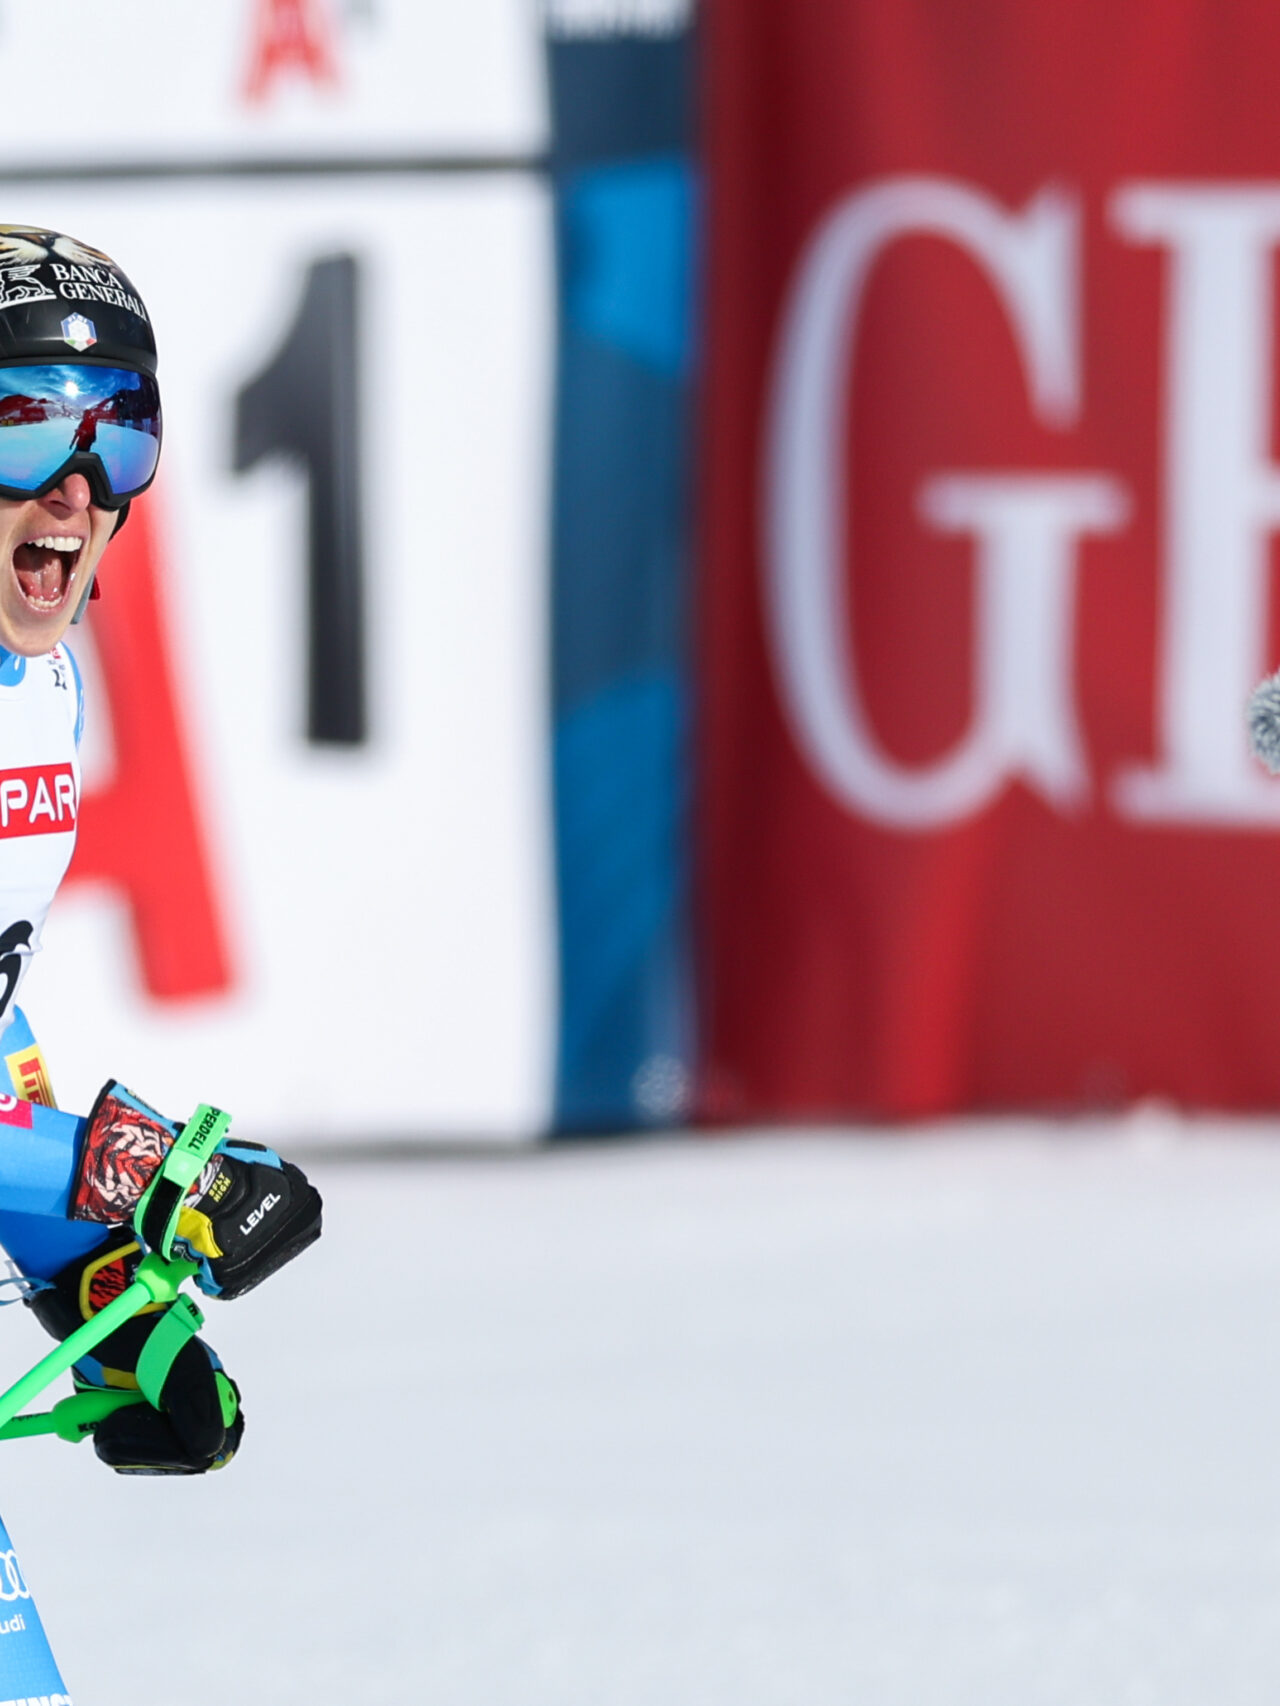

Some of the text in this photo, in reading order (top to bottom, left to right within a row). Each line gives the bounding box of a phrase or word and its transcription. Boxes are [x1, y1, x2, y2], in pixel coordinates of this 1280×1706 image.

[49, 262, 122, 289] BANCA
[59, 281, 147, 323] GENERALI
[240, 1192, 282, 1236] LEVEL
